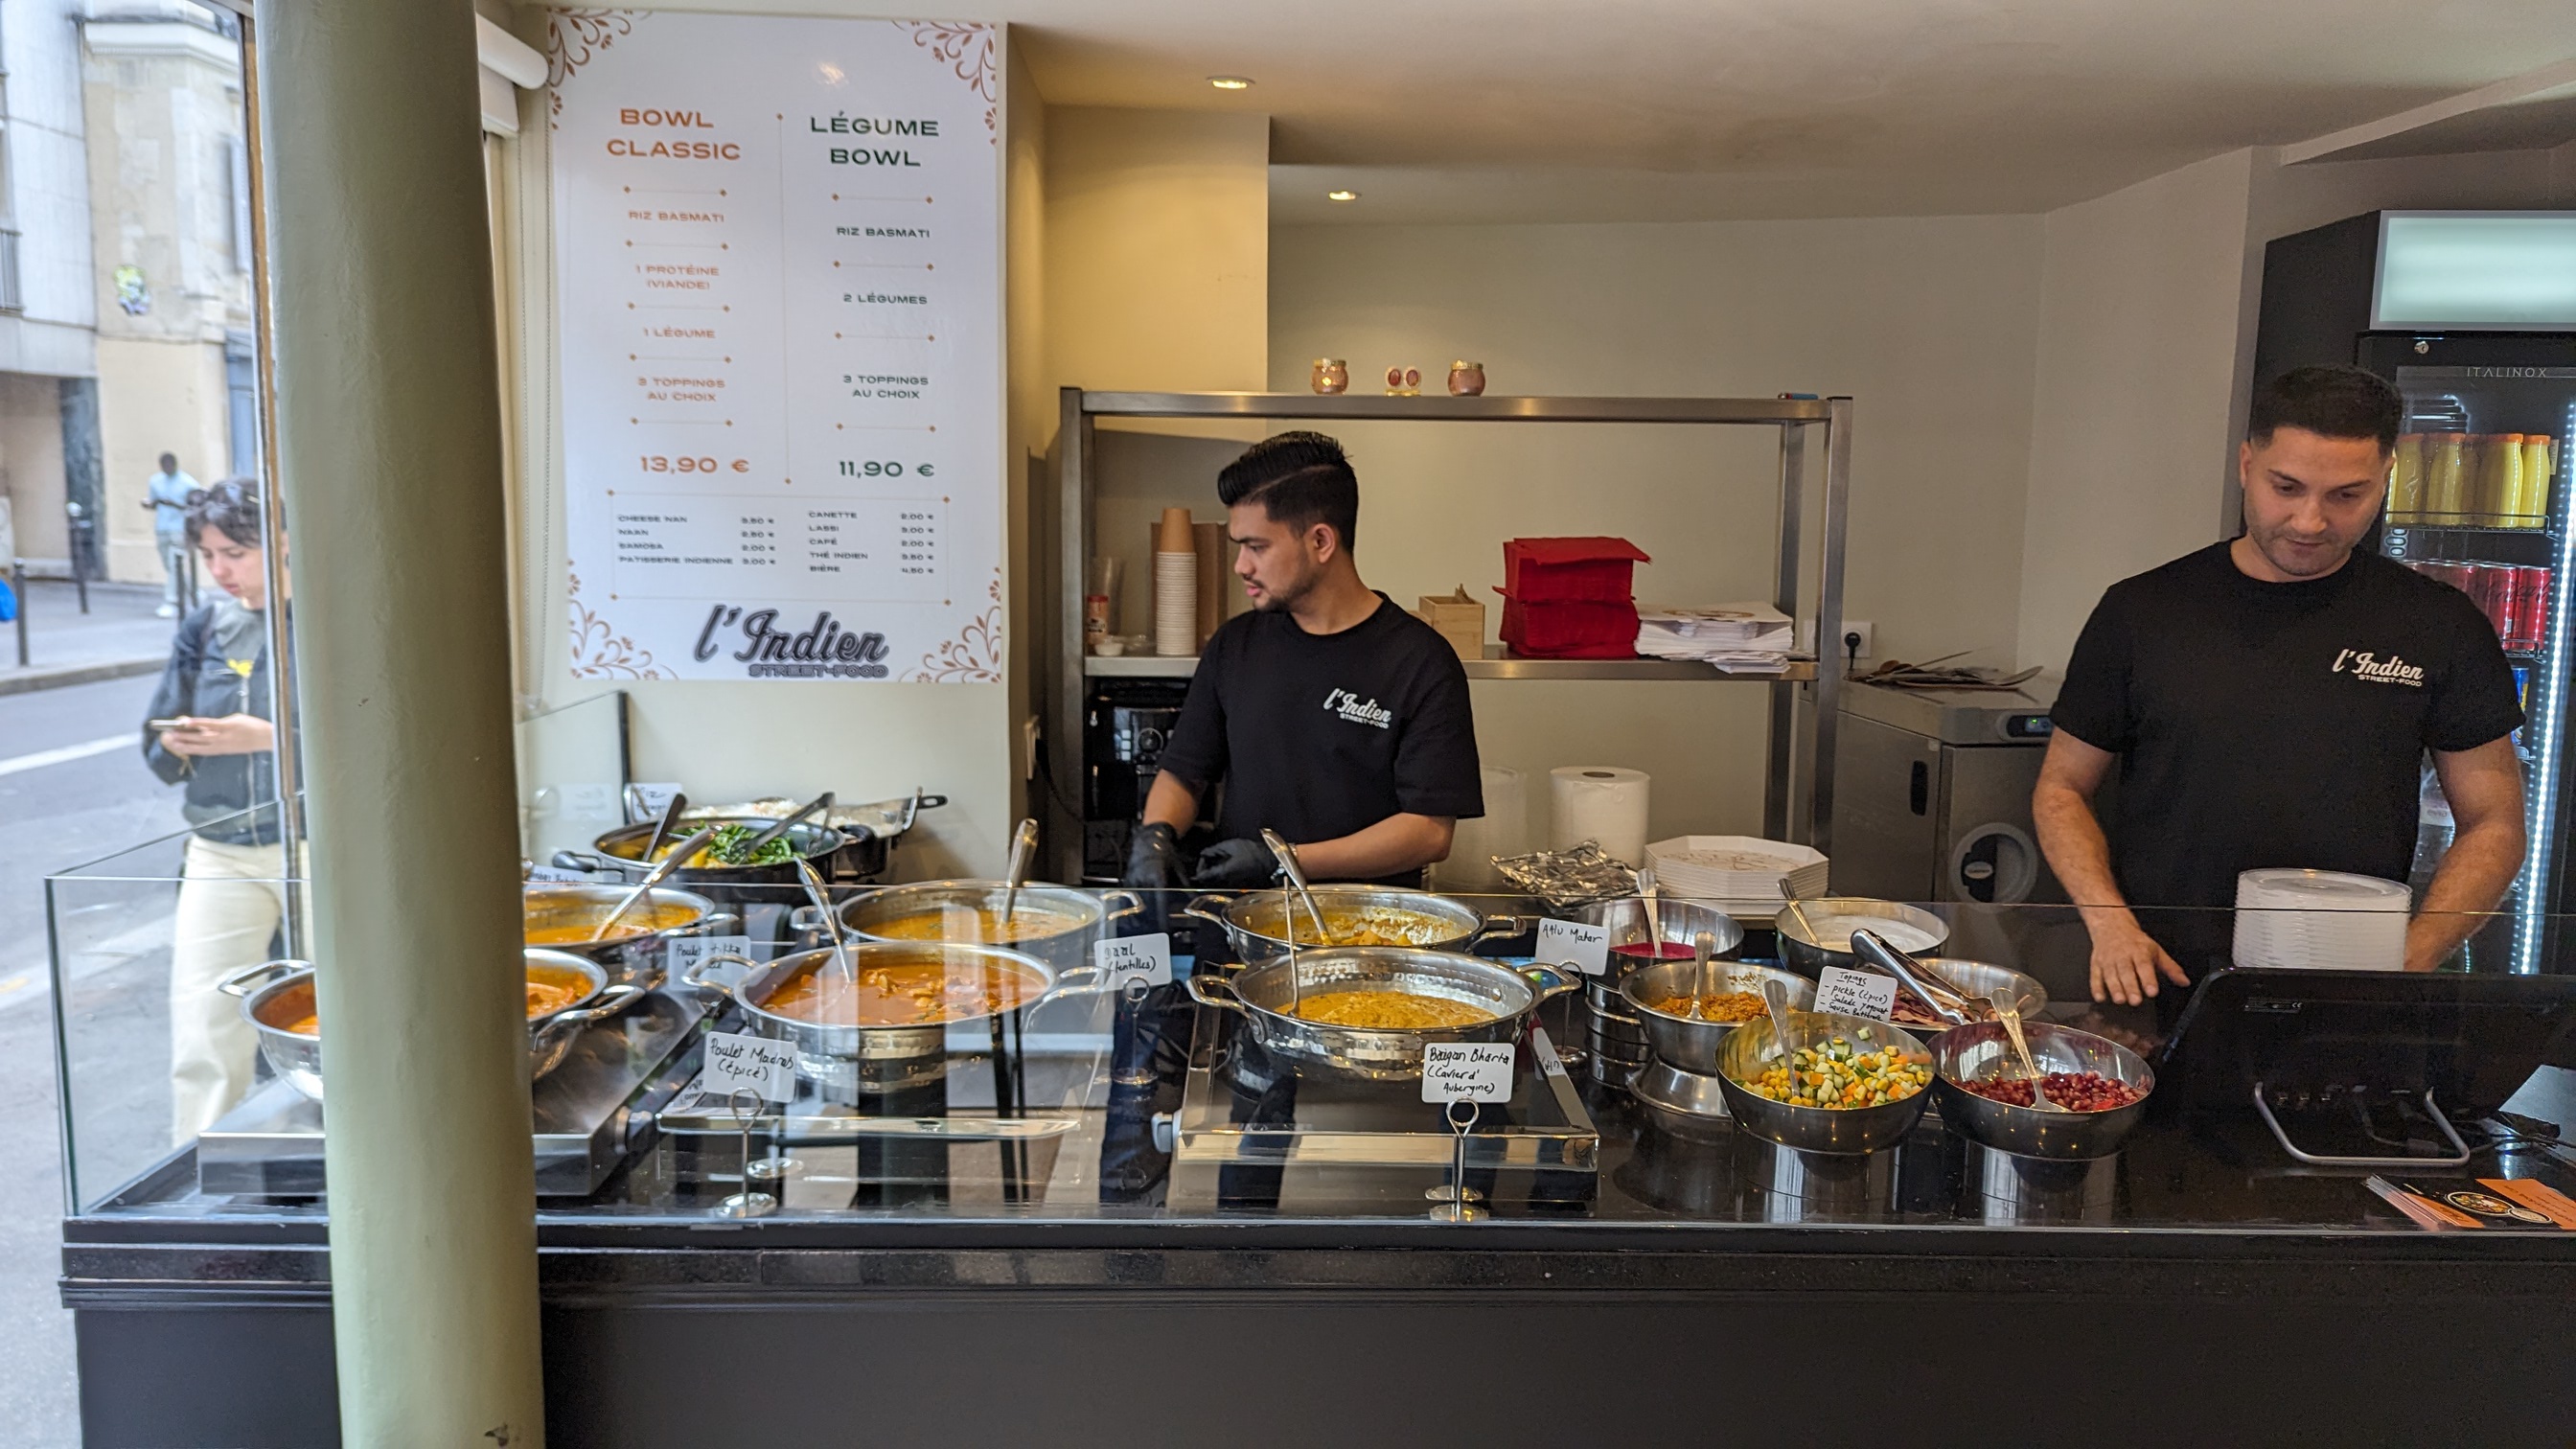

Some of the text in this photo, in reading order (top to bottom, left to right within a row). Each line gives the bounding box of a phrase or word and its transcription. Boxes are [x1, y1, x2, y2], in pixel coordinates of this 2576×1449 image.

[620, 107, 714, 128] BOWL
[810, 110, 939, 137] LÉGUME
[606, 138, 741, 161] CLASSIC
[830, 148, 921, 167] BOWL
[628, 210, 724, 223] RIZ BASMATI
[836, 226, 931, 239] RIZ BASMATI
[634, 264, 720, 277] 1 PROTÉINE
[647, 279, 711, 290] (VIANDE)
[842, 291, 928, 305] 2 LÉGUMES
[642, 326, 716, 339] 1 LÉGUME
[2467, 367, 2547, 378] ITALINOX
[637, 377, 726, 389] 3 TOPPINGS
[842, 375, 930, 386] 3 TOPPINGS
[647, 391, 717, 402] AU CHOIX
[852, 388, 920, 400] AU CHOIX
[640, 455, 749, 474] 13,90 €
[839, 460, 934, 479] 11,90 €
[617, 515, 661, 523] CHEESE
[808, 511, 858, 519] CANETTE
[617, 528, 650, 537] NAAN
[618, 541, 664, 550] SAMOSA
[808, 537, 838, 546] CAFÉ
[683, 557, 733, 565] INDIENNE
[809, 550, 830, 560] THÉ
[809, 564, 840, 573] BIÈRE
[693, 604, 889, 663] l'Indien
[748, 663, 888, 678] STREET-FOOD
[2332, 649, 2425, 680] l'Indien
[2358, 674, 2423, 687] STREET-FOOD
[1322, 687, 1392, 723] l'Indien
[1339, 712, 1390, 729] STREET-FOOD
[709, 1037, 794, 1070] Poulet Madras
[1429, 1046, 1510, 1068] Baigan Bharta
[1443, 1082, 1496, 1097] Aubergine)
